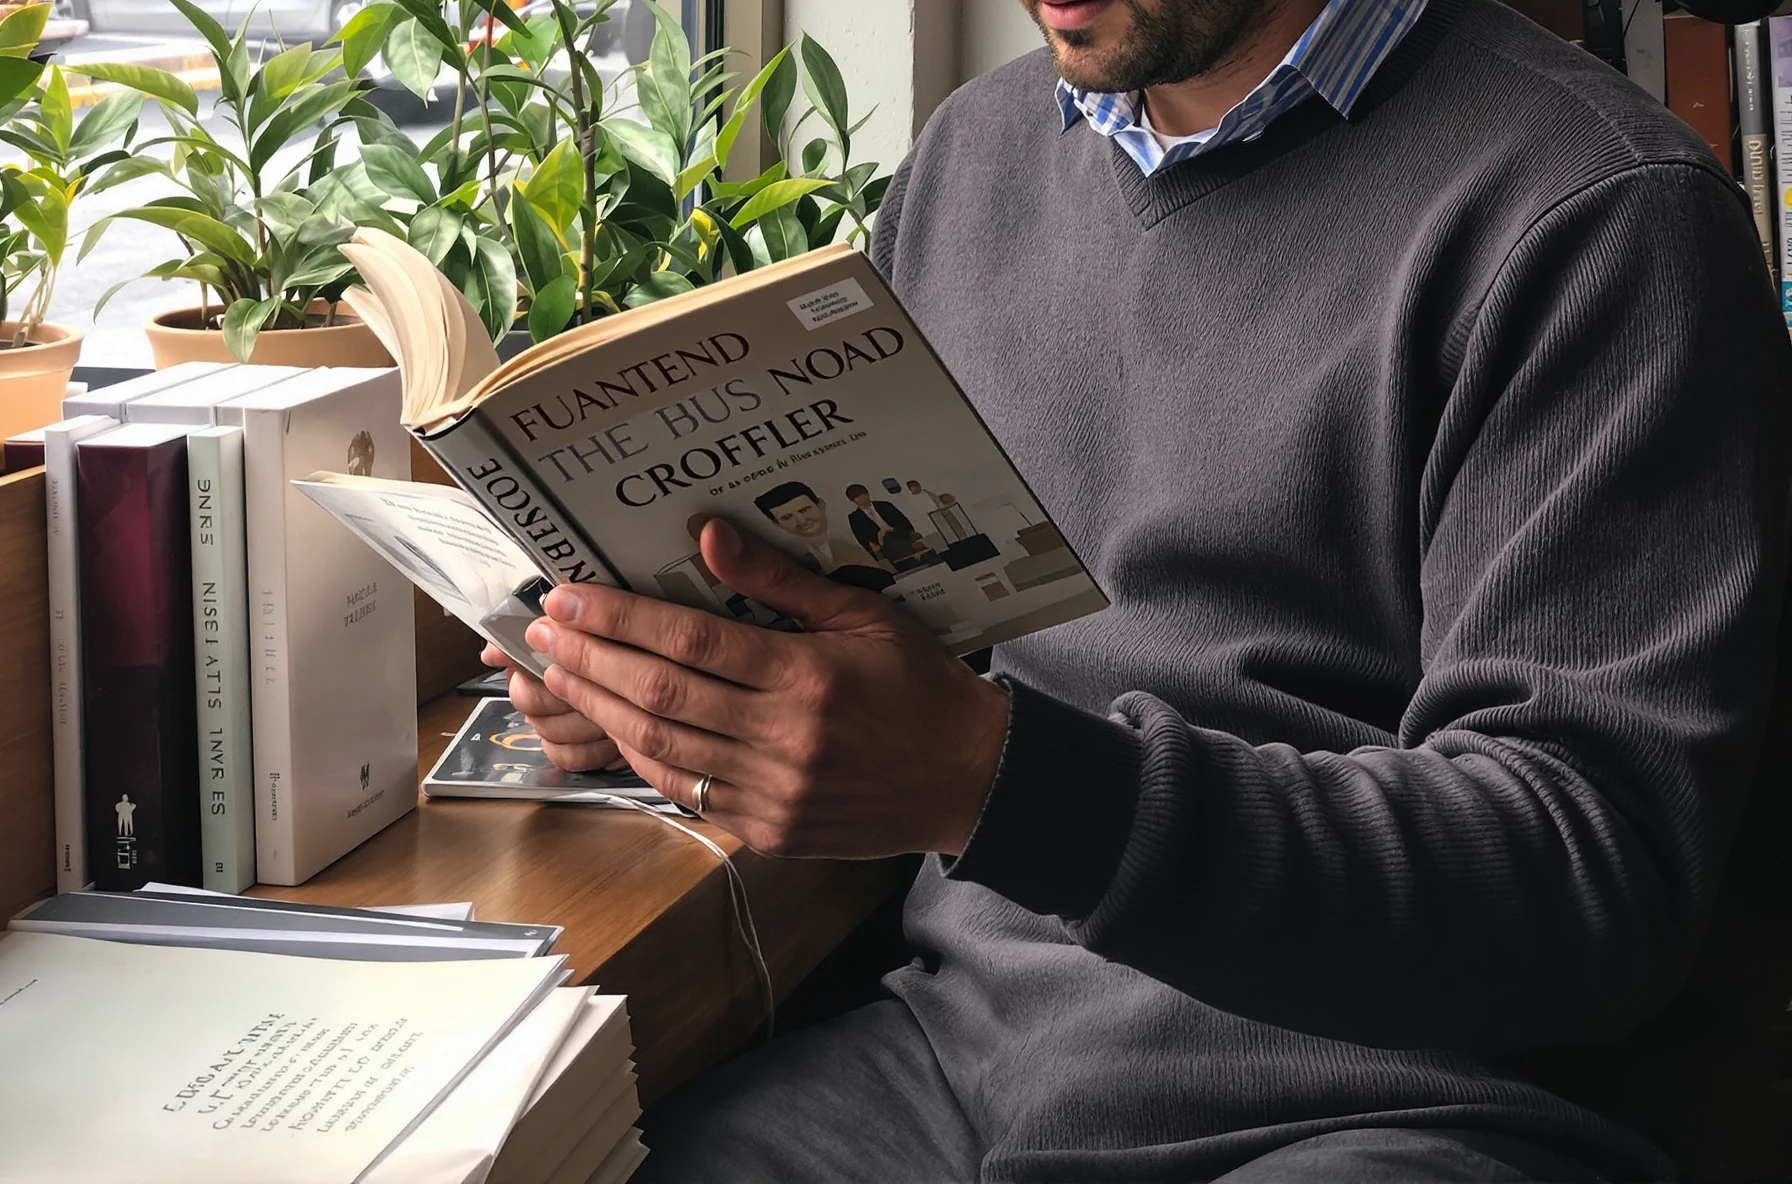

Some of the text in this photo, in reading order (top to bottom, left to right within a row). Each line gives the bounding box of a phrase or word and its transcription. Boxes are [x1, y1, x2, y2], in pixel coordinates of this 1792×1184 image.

[510, 333, 750, 441] FUANTEND
[538, 423, 649, 482] THE
[766, 327, 904, 395] NOAD
[616, 399, 854, 507] CROFFLER
